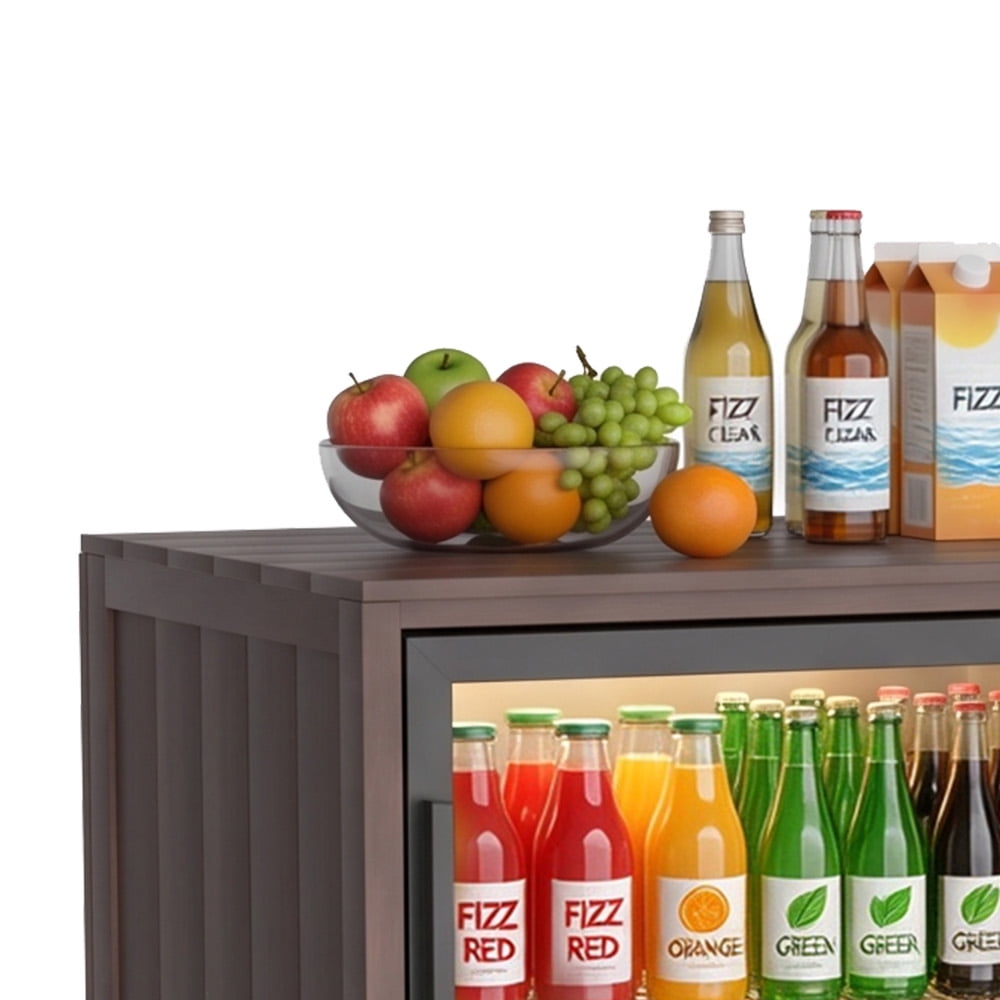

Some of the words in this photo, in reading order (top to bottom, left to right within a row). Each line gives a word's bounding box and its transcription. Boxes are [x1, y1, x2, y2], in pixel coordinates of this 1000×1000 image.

[823, 398, 874, 422] FIZZ
[457, 900, 519, 931] FIZZ
[565, 898, 624, 929] FIZZ
[463, 937, 516, 963] RED
[567, 935, 619, 962] RED
